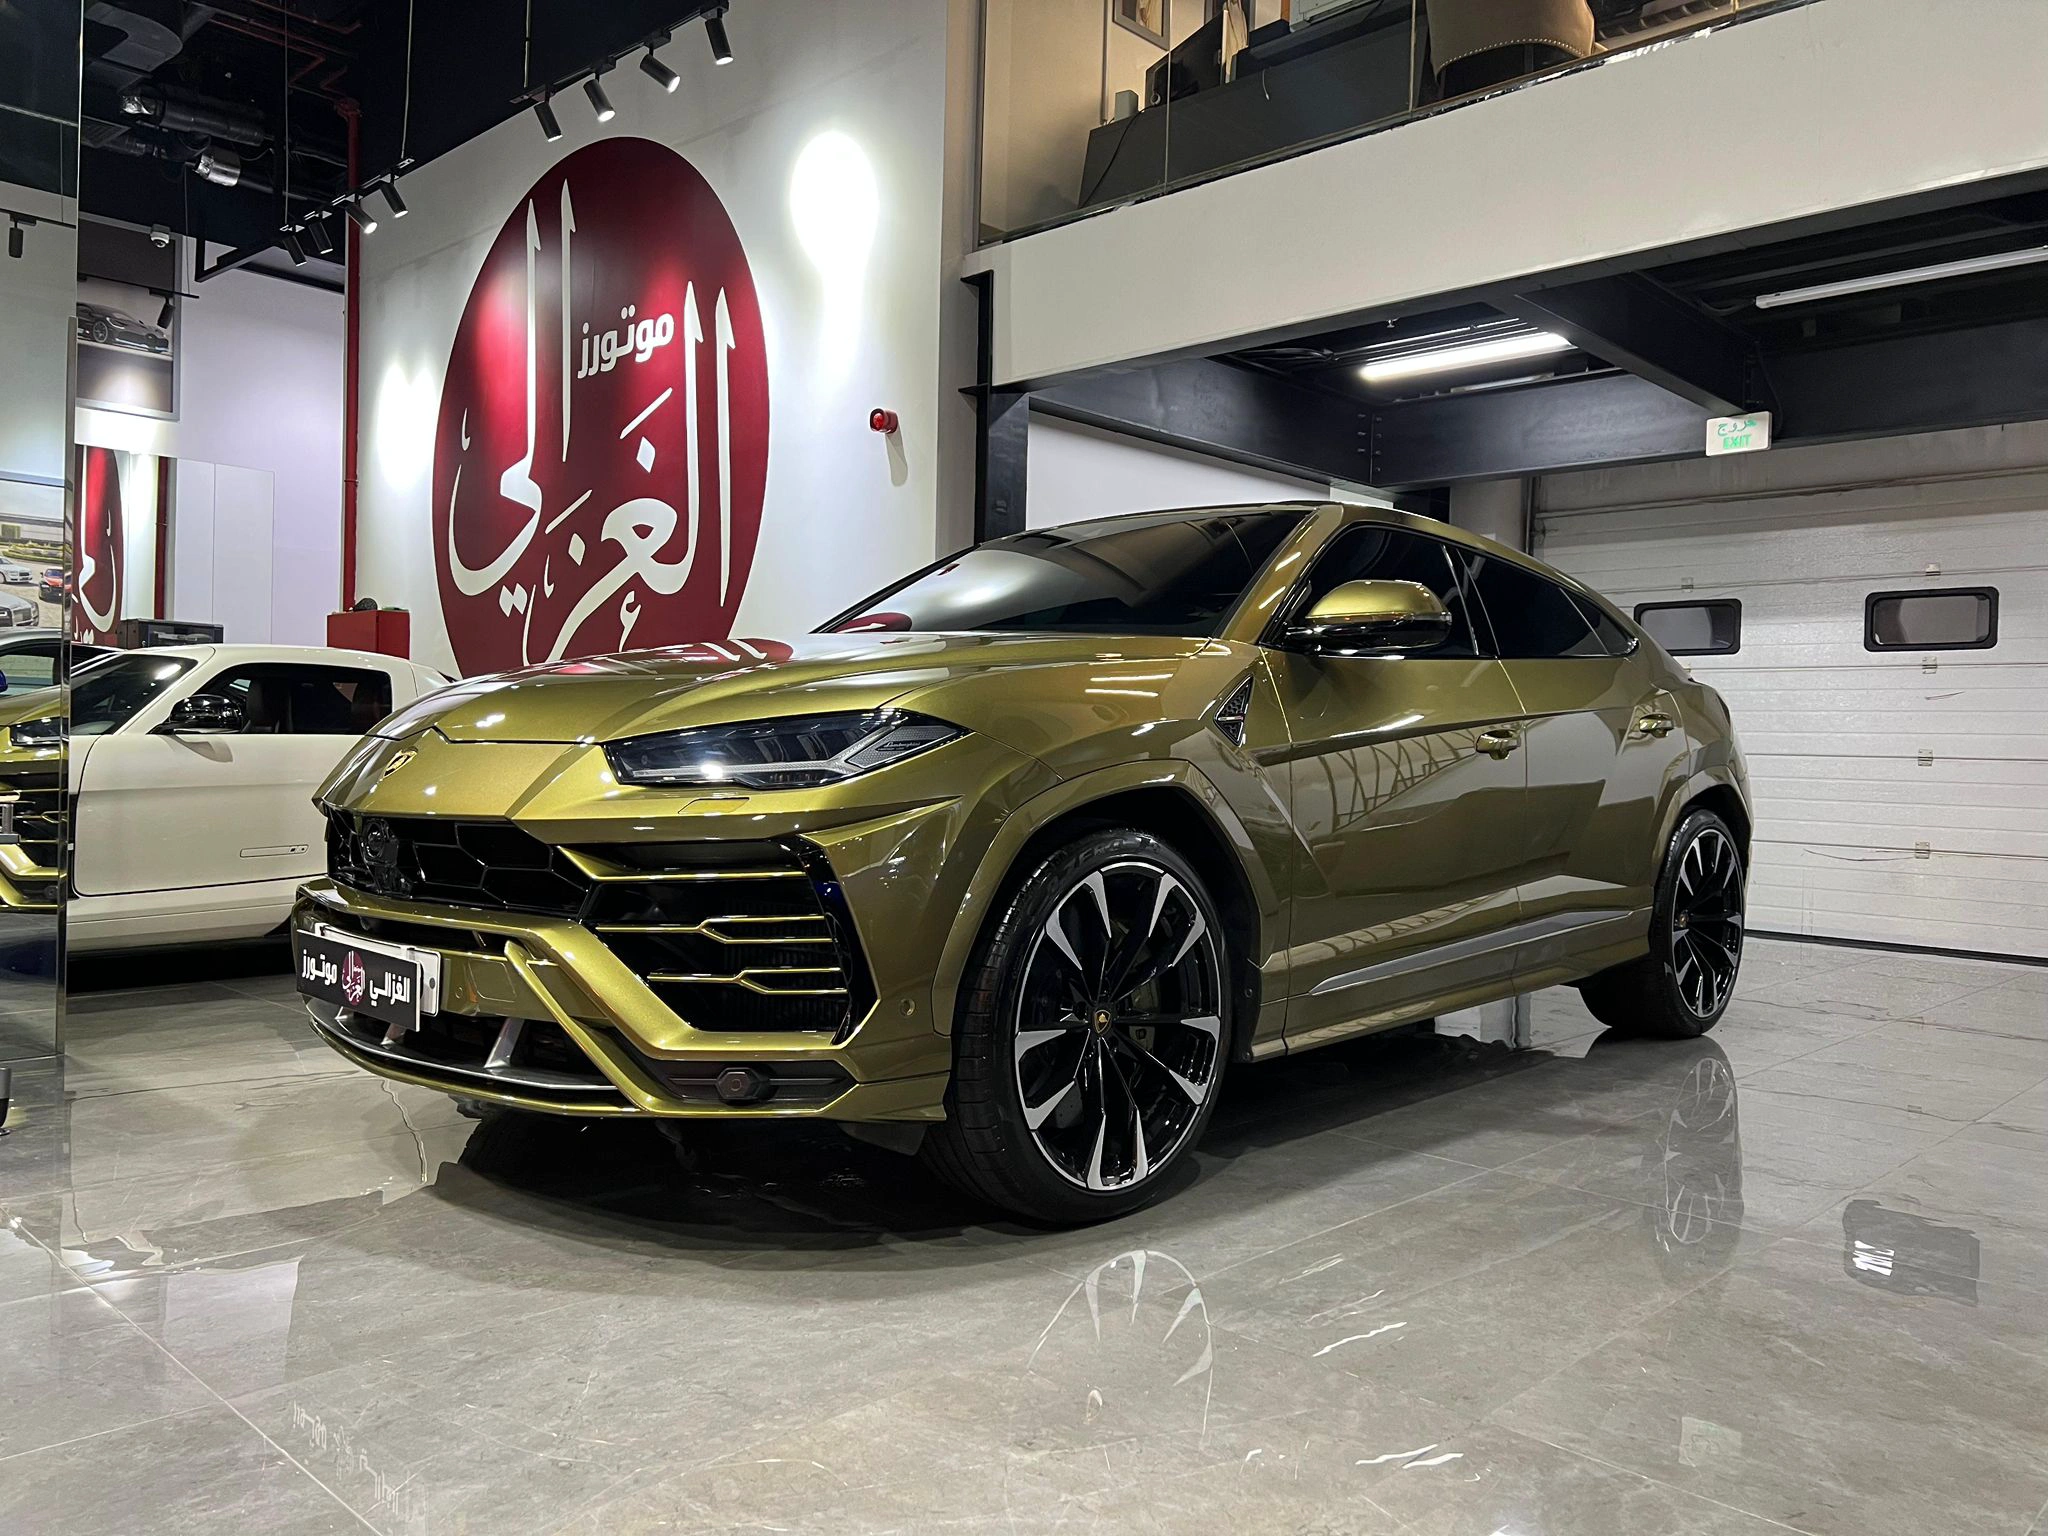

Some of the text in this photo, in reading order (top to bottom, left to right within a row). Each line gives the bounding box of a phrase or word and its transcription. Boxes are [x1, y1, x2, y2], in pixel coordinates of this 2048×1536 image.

[577, 304, 675, 379] موتورز
[1723, 434, 1751, 449] EXIT
[302, 949, 411, 1007] الغزالي موتورز
